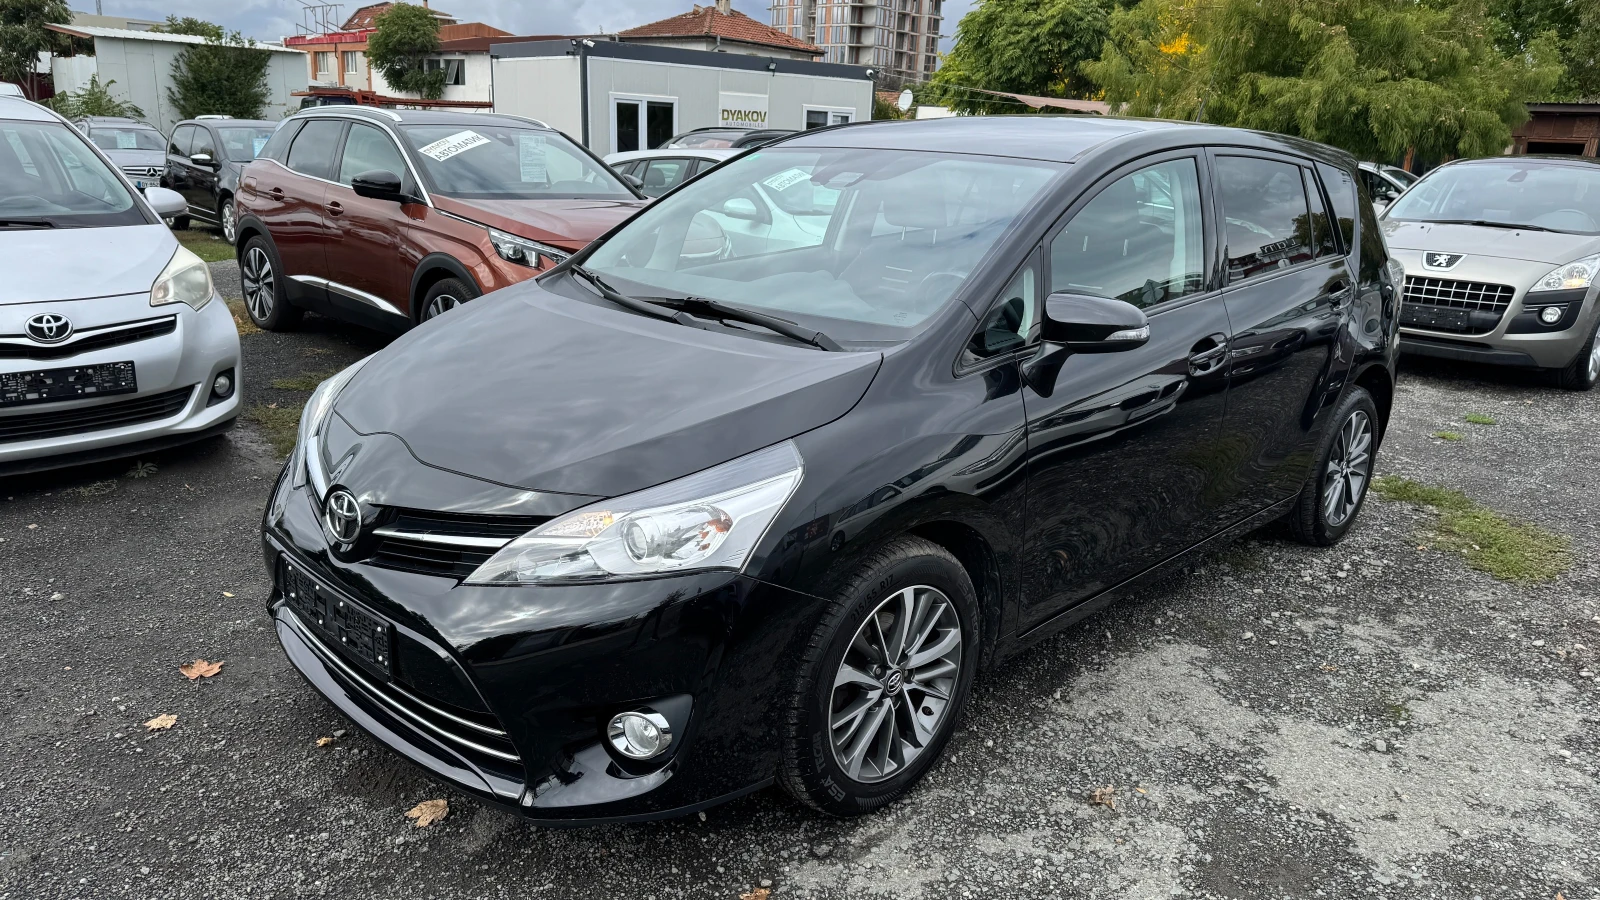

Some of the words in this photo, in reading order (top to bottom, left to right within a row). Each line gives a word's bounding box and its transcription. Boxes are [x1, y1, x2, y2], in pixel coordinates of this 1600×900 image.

[721, 108, 767, 122] DYAKOV
[850, 588, 877, 621] 215/55
[880, 573, 894, 590] R17
[812, 730, 827, 774] TECAR
